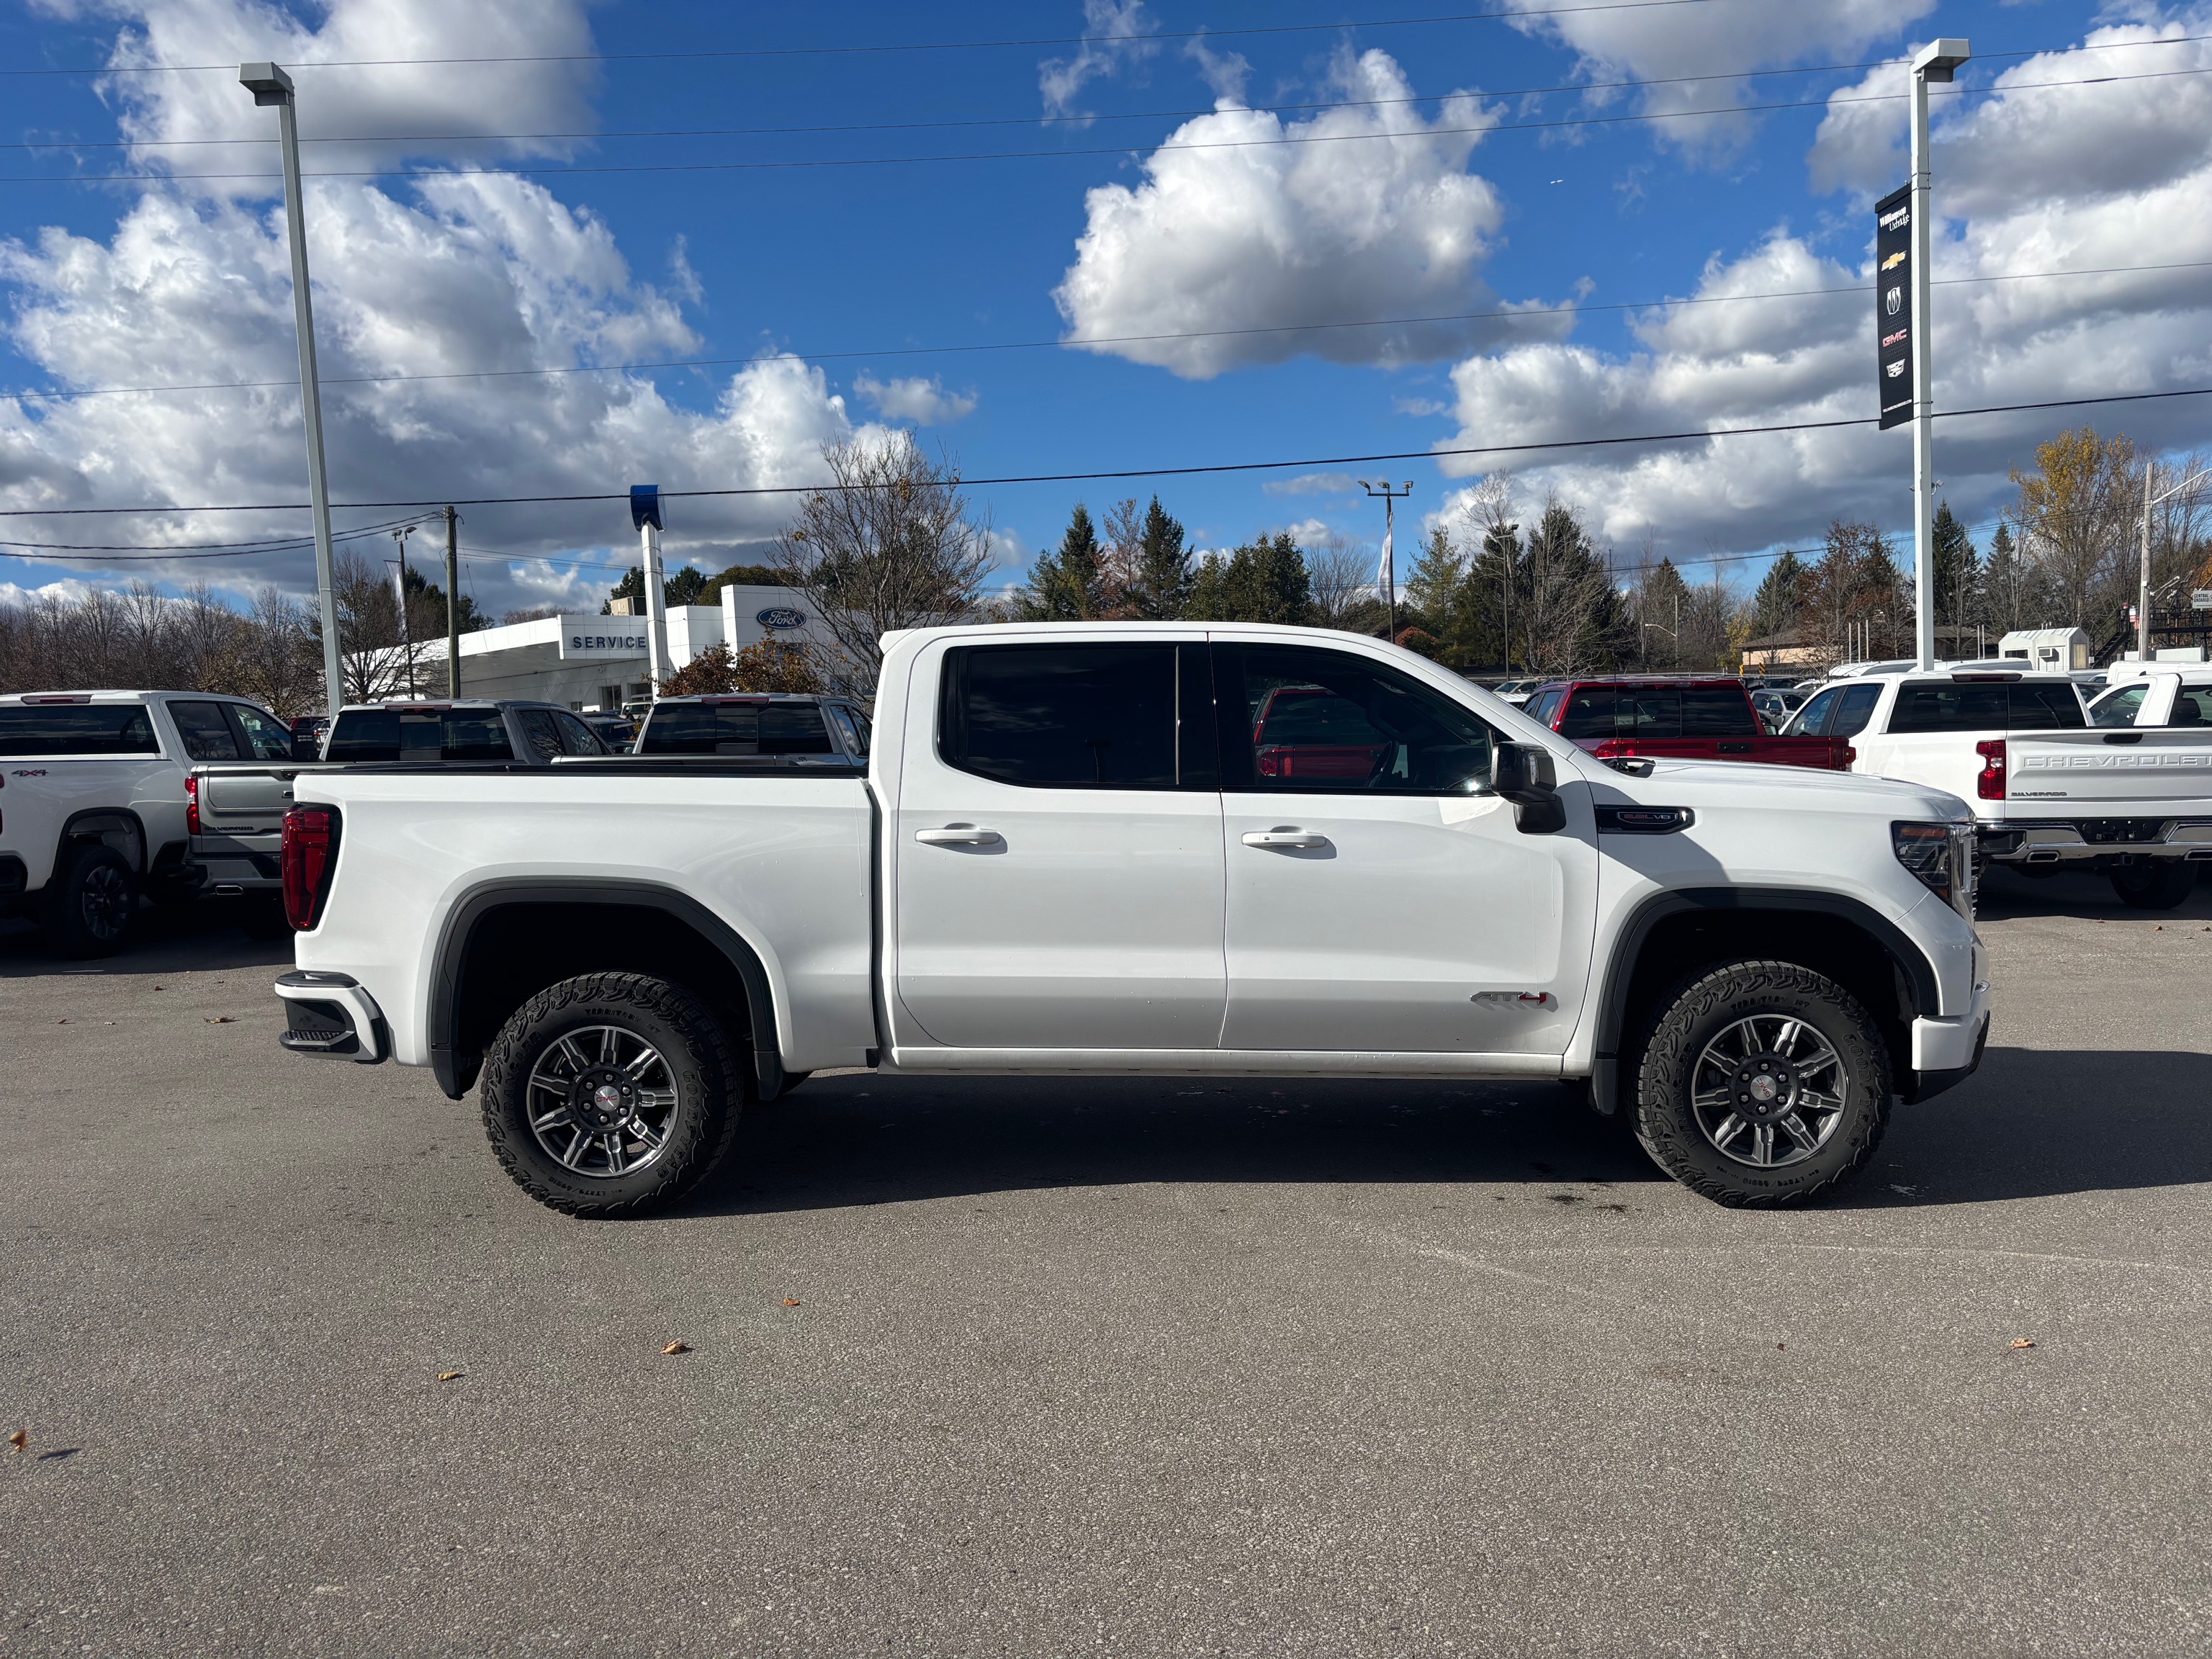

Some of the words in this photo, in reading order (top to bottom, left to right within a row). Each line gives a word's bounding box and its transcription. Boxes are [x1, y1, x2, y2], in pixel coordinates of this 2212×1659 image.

[1882, 328, 1907, 347] GMC
[573, 637, 647, 648] SERVICE
[1470, 991, 1547, 1006] AT4
[503, 1030, 541, 1131] WRANGLER
[1673, 1041, 1698, 1148] WRANGLER
[1756, 1077, 1771, 1098] GMC
[1843, 1033, 1871, 1147] GOODYEAR
[656, 1070, 700, 1179] GOODYEAR
